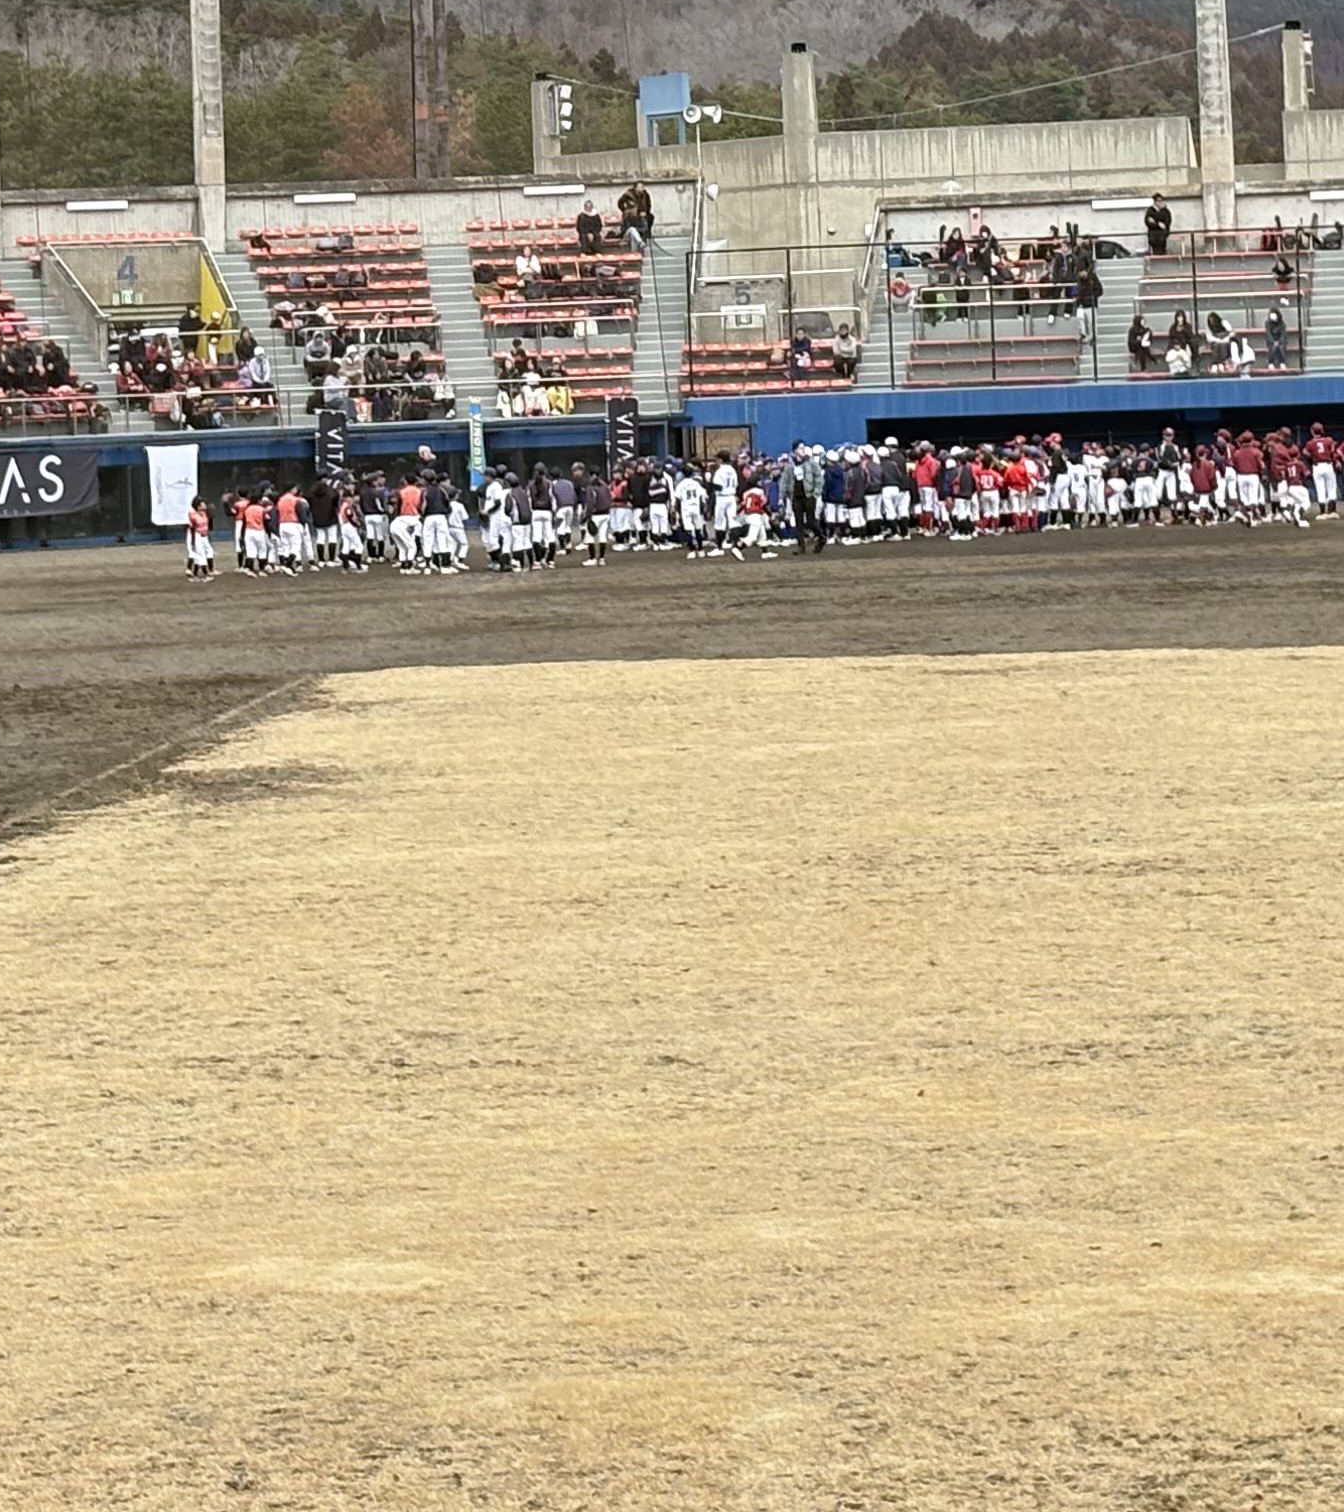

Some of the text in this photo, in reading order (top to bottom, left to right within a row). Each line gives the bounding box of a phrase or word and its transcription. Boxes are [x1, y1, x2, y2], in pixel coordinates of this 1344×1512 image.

[117, 255, 139, 287] 4
[735, 283, 751, 305] 5
[616, 411, 634, 463] VITA
